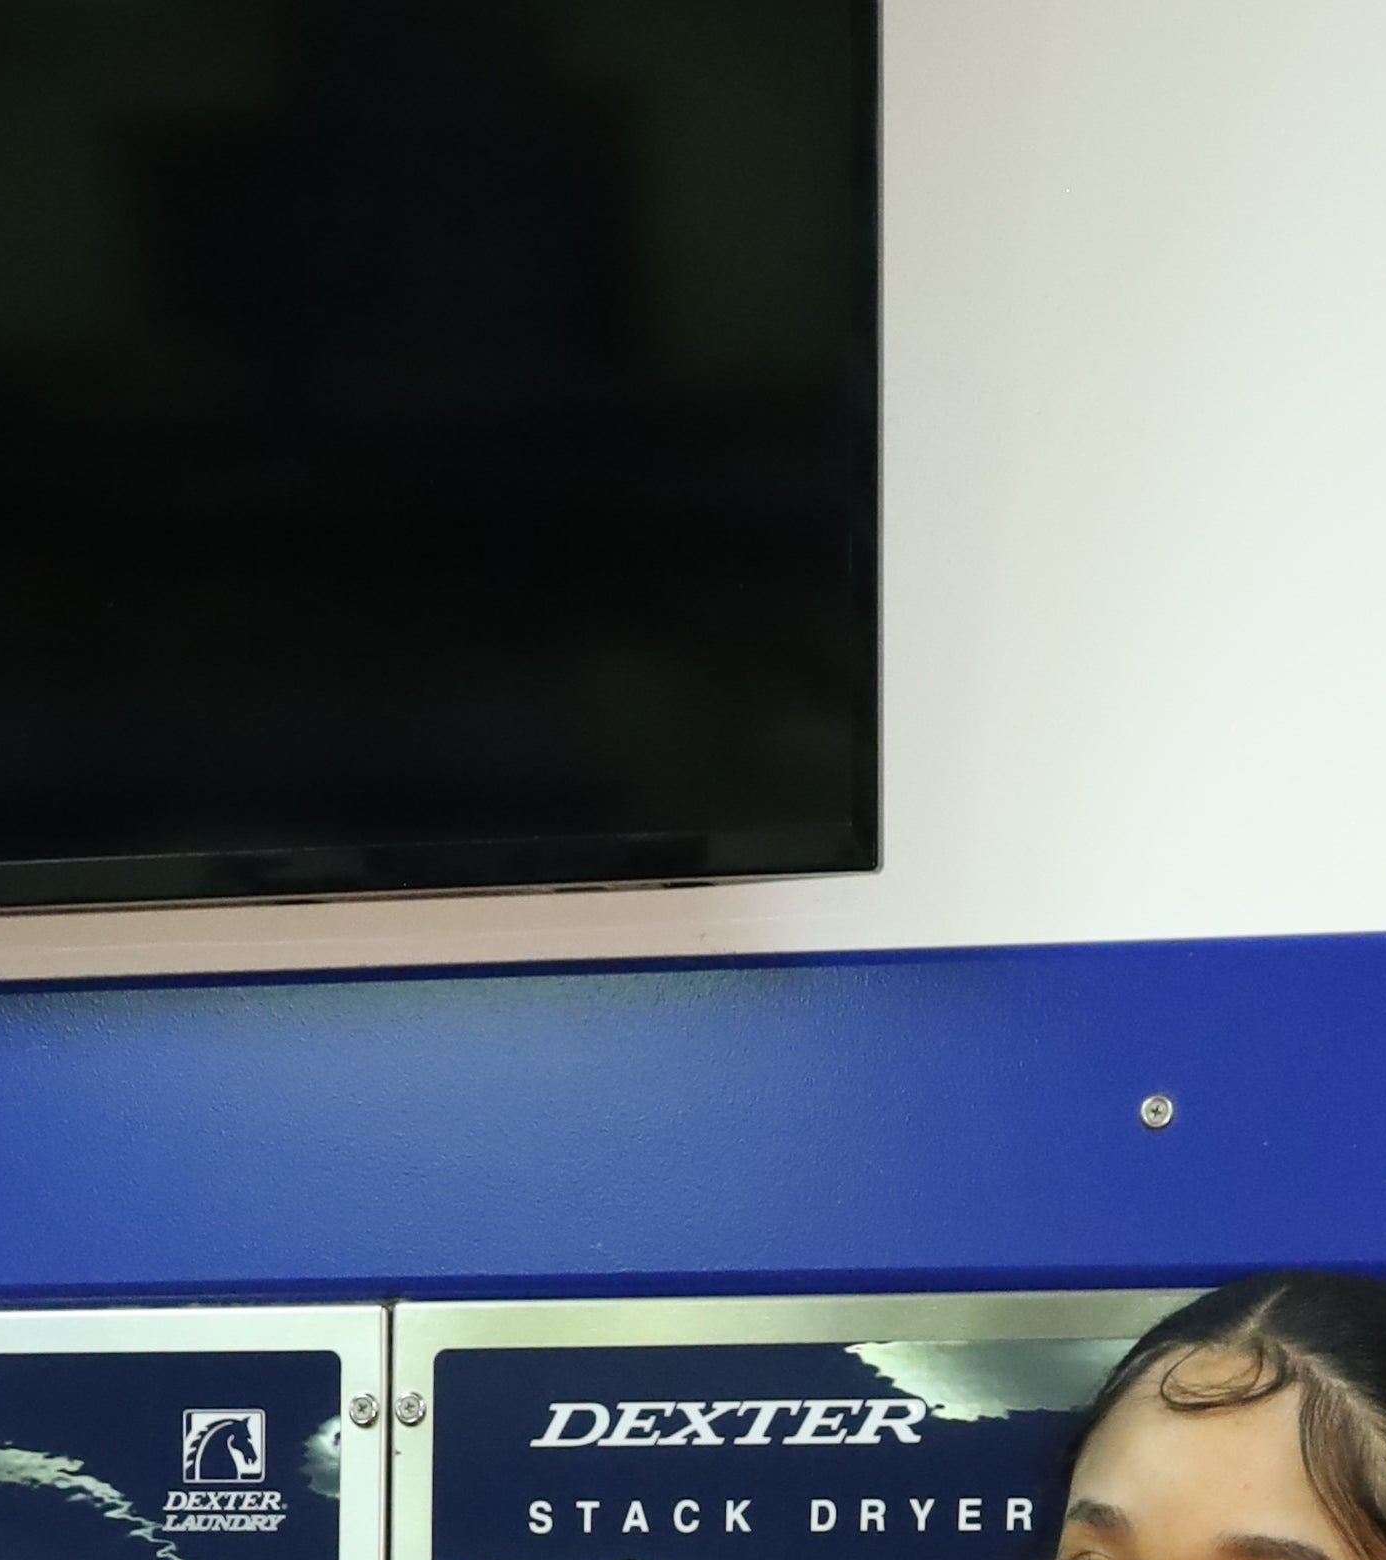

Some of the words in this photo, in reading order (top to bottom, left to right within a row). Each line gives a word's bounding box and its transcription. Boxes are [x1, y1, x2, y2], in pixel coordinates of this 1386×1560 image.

[530, 1398, 927, 1447] DEXTER
[163, 1491, 282, 1511] DEXTER
[162, 1513, 286, 1532] LAUNDRY
[528, 1500, 753, 1534] STACK
[810, 1498, 1034, 1532] DRYER
